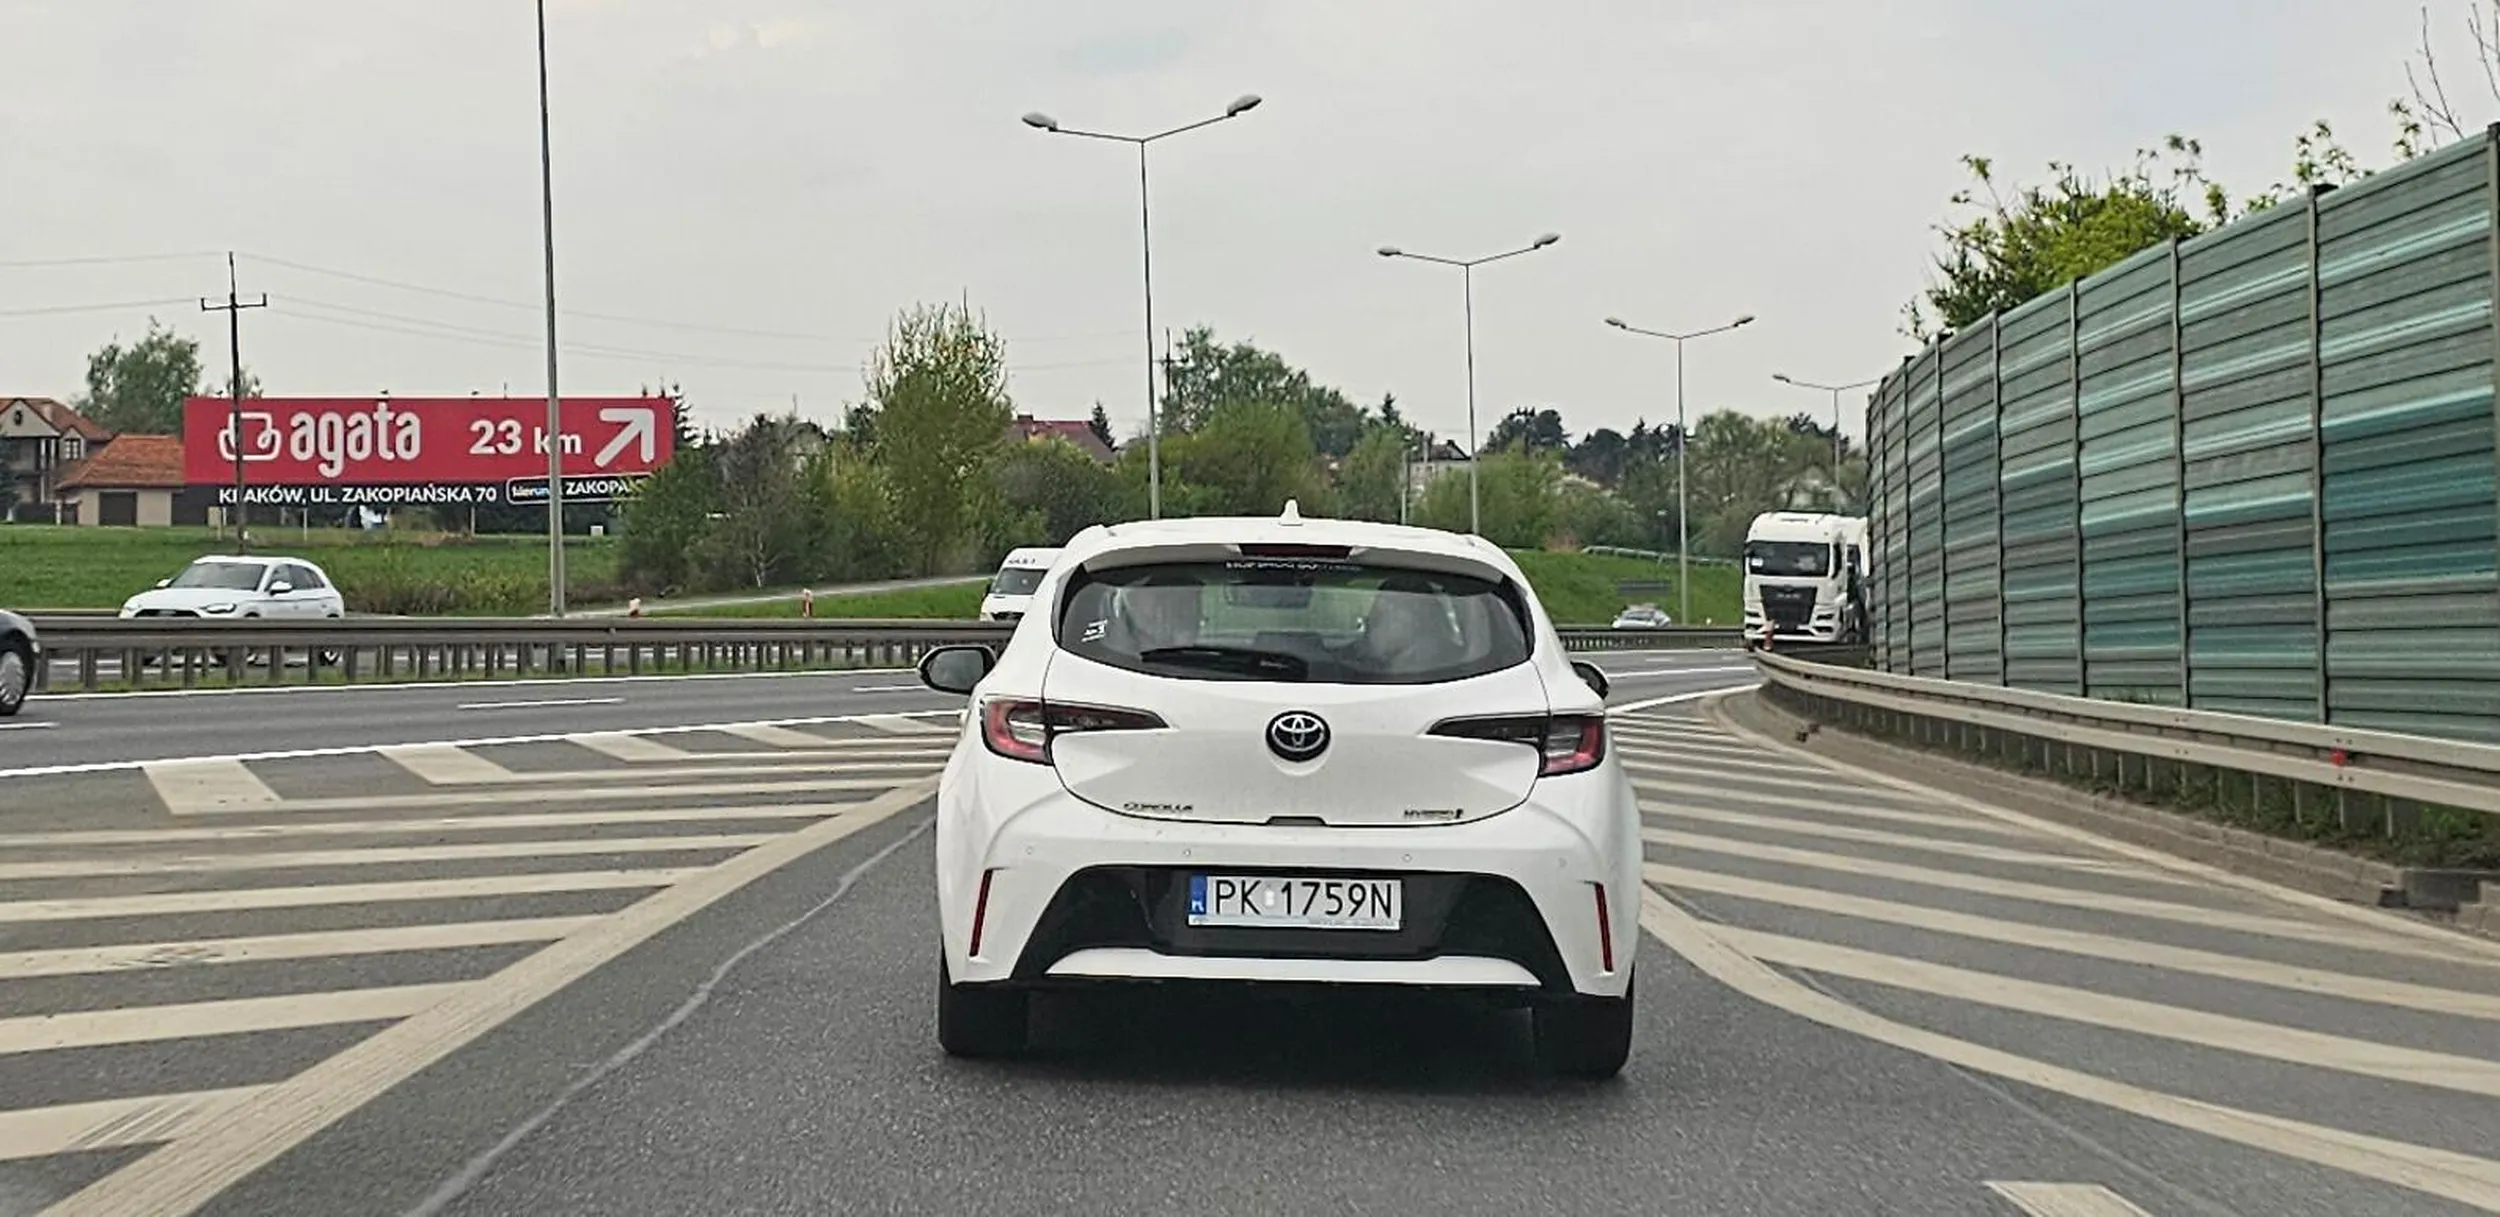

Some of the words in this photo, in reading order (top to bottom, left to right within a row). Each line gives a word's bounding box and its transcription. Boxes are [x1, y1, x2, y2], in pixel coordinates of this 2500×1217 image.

[290, 402, 421, 478] agata
[469, 419, 522, 454] 23
[533, 426, 582, 454] km
[341, 483, 472, 503] ZAKOPIAŃSKA
[475, 487, 497, 502] 70
[1215, 879, 1262, 915] PK
[1281, 881, 1392, 919] 1759N
